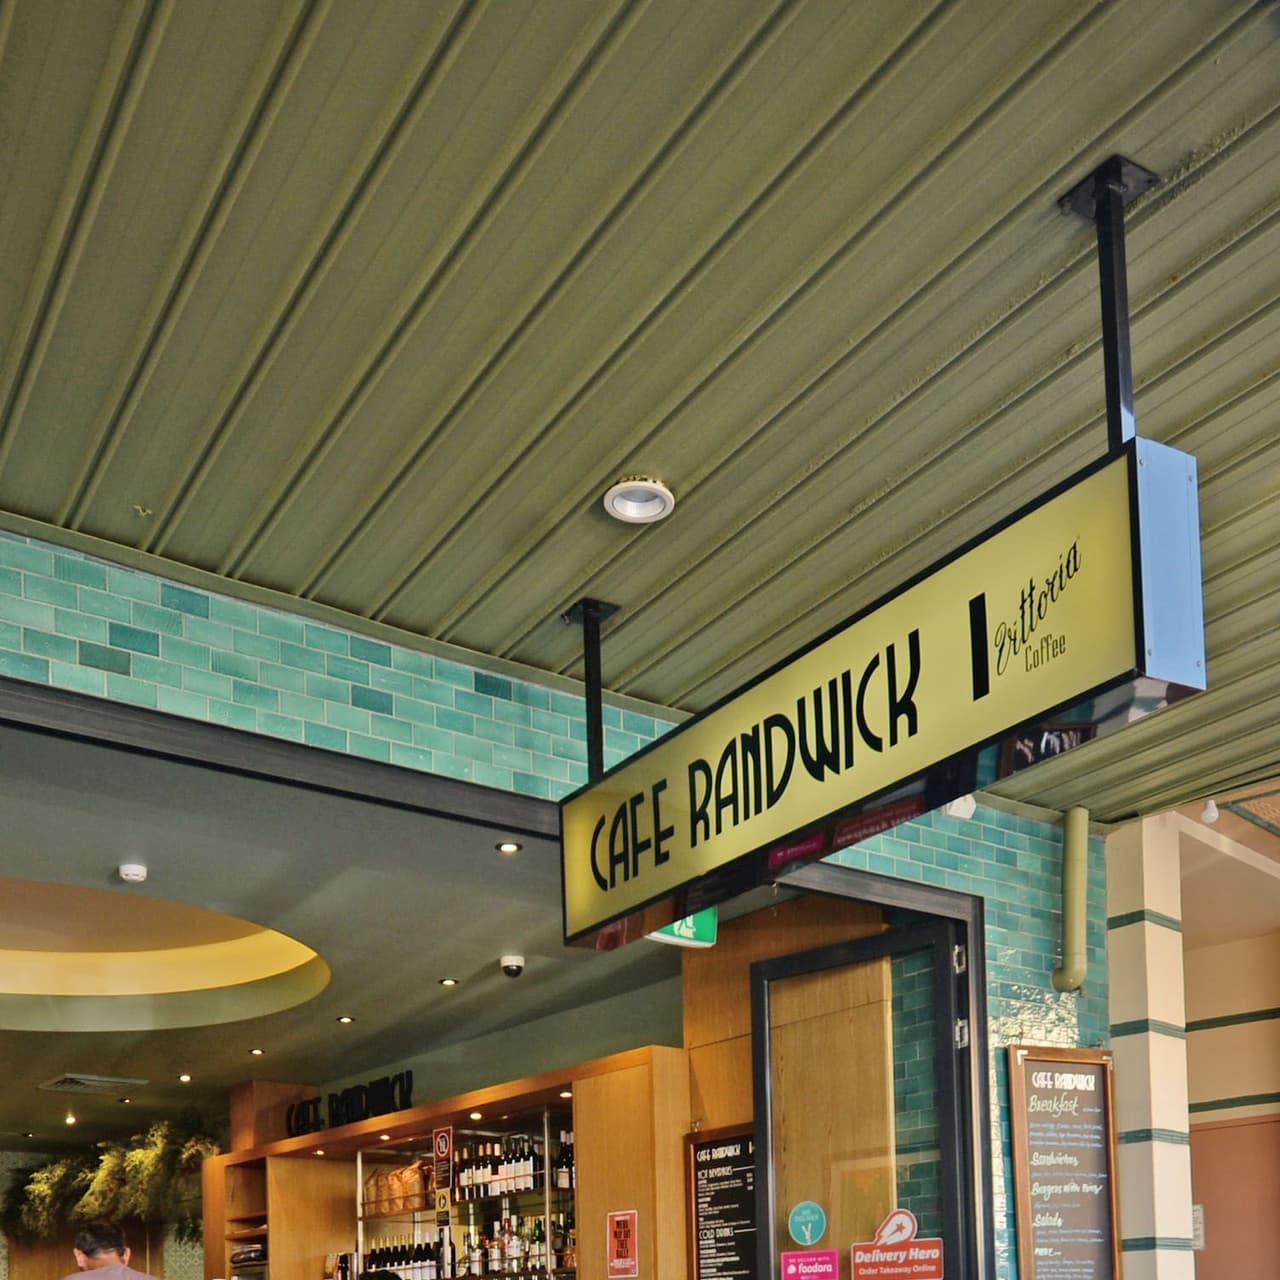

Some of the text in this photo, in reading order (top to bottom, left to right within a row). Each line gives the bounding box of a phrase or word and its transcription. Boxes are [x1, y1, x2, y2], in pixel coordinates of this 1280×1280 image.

[994, 536, 1082, 677] Vittoria
[1024, 632, 1067, 673] Coffee
[591, 629, 921, 892] CAFE RANDWICK
[1028, 1092, 1080, 1118] Breakfast
[798, 1263, 833, 1275] foodora
[855, 1248, 940, 1264] Delivery Hero
[859, 1264, 937, 1276] Order Takeaway Online
